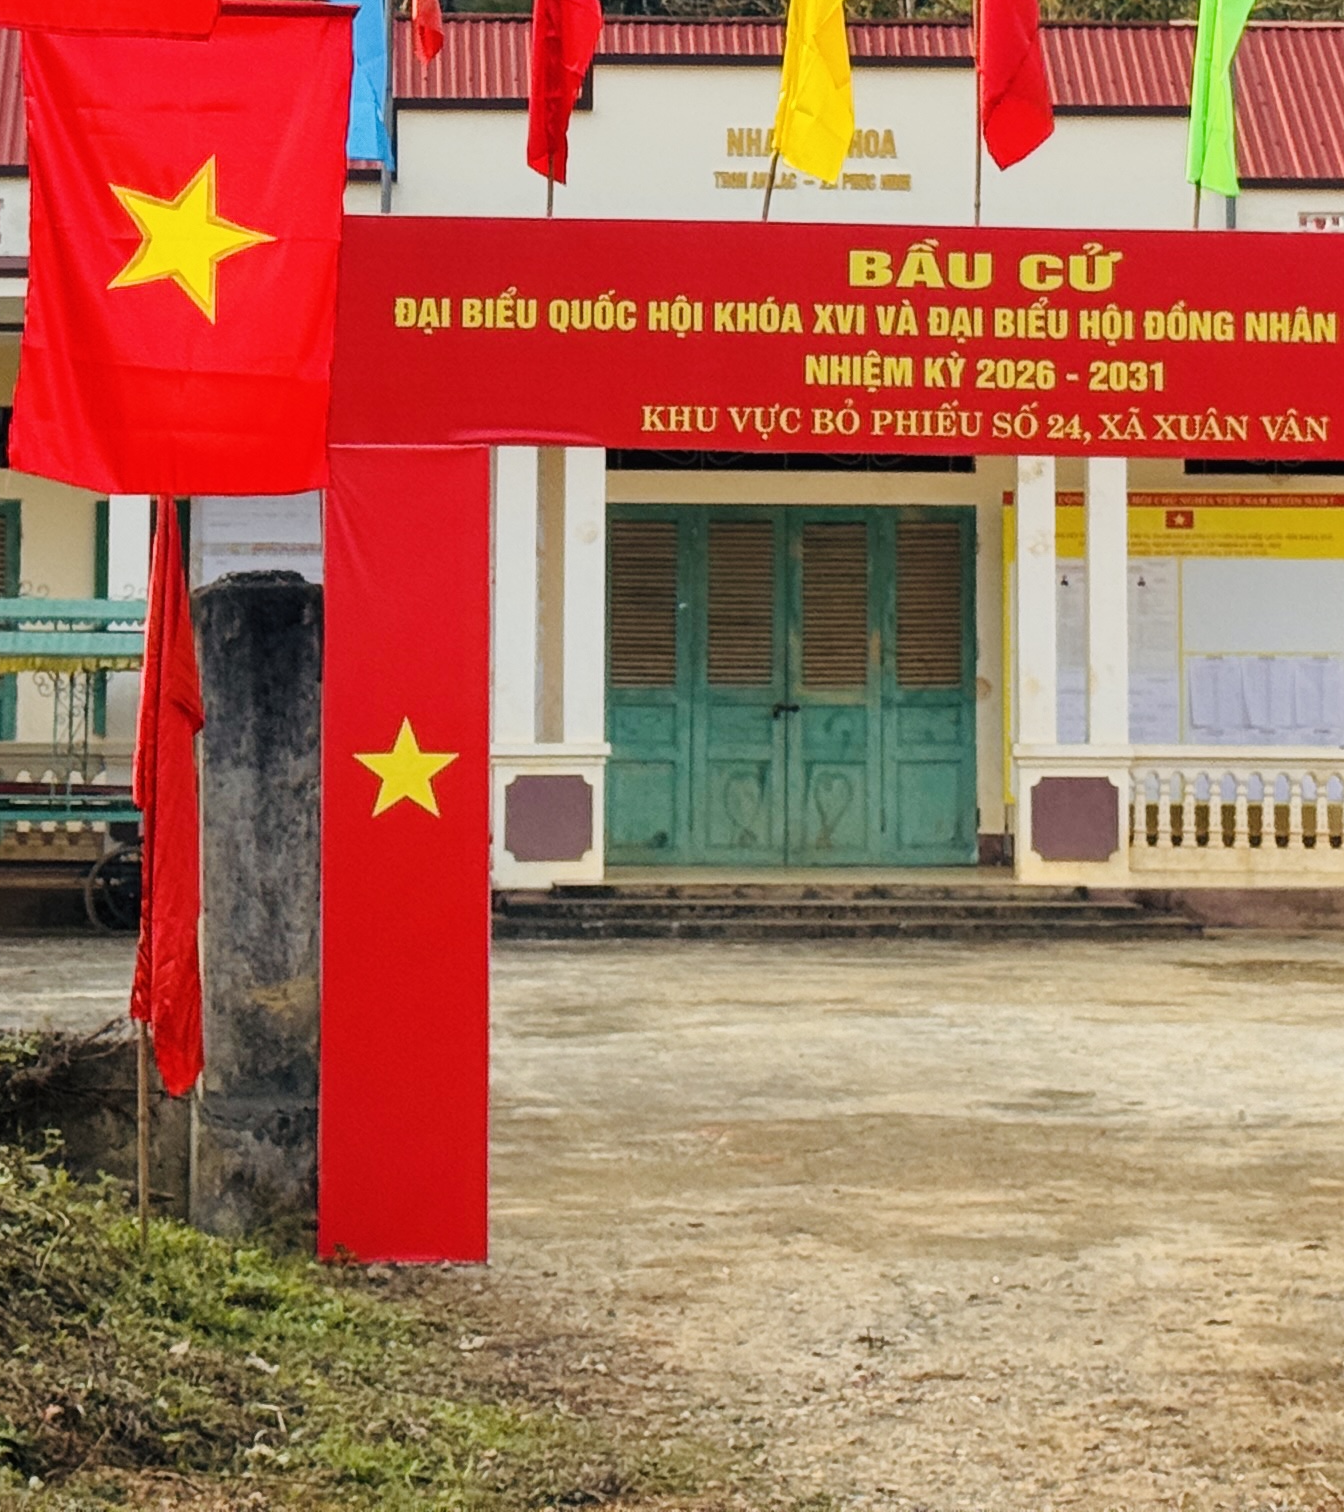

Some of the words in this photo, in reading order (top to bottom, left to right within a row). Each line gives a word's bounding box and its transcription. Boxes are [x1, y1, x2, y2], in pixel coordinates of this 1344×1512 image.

[848, 239, 993, 289] BẦU
[1019, 241, 1123, 292] CỬ
[394, 297, 451, 335] ĐẠI
[461, 286, 538, 330] BIỂU
[548, 289, 637, 334] QUỐC
[647, 295, 703, 338] HỘI
[714, 296, 803, 334] KHÓA
[813, 303, 865, 335] XVI
[876, 299, 919, 337] VÀ
[928, 306, 983, 343] ĐẠI
[994, 297, 1069, 340] BIỂU
[1079, 303, 1133, 347] HỘI
[1144, 300, 1234, 341] ĐỒNG
[1245, 306, 1336, 343] NHÂN
[805, 350, 913, 392] NHIỆM
[924, 351, 966, 387] KỲ
[976, 359, 1056, 389] 2026
[1088, 361, 1165, 392] 2031
[641, 406, 718, 432] KHU
[727, 404, 802, 440] VỰC
[812, 398, 860, 436] BỎ
[870, 400, 983, 438] PHIẾU
[992, 402, 1039, 439] SỐ
[1046, 413, 1092, 445] 24,
[1098, 407, 1147, 441] XÃ
[1152, 407, 1249, 441] XUÂN
[1259, 408, 1329, 442] VÂN
